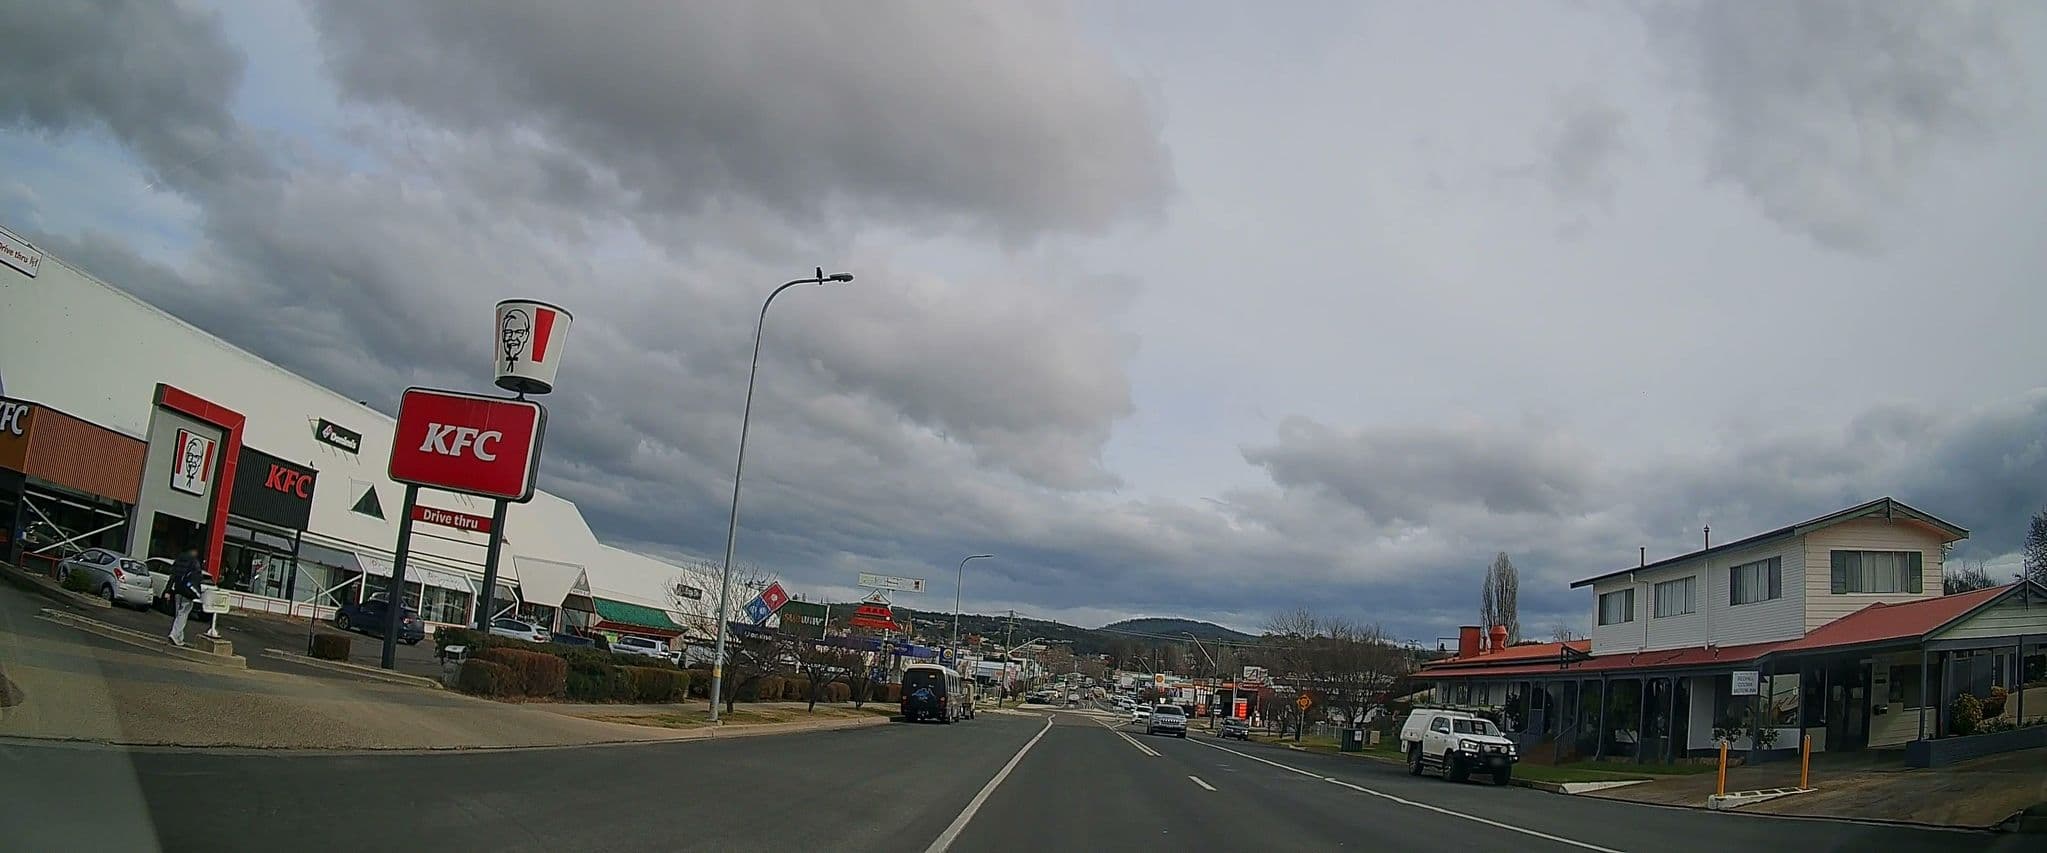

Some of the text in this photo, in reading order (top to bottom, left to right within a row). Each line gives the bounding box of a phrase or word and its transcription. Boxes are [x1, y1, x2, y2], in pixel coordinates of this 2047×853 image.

[14, 251, 28, 263] thru
[419, 422, 502, 461] KFC
[265, 464, 312, 498] KFC
[423, 509, 478, 529] Drive thru
